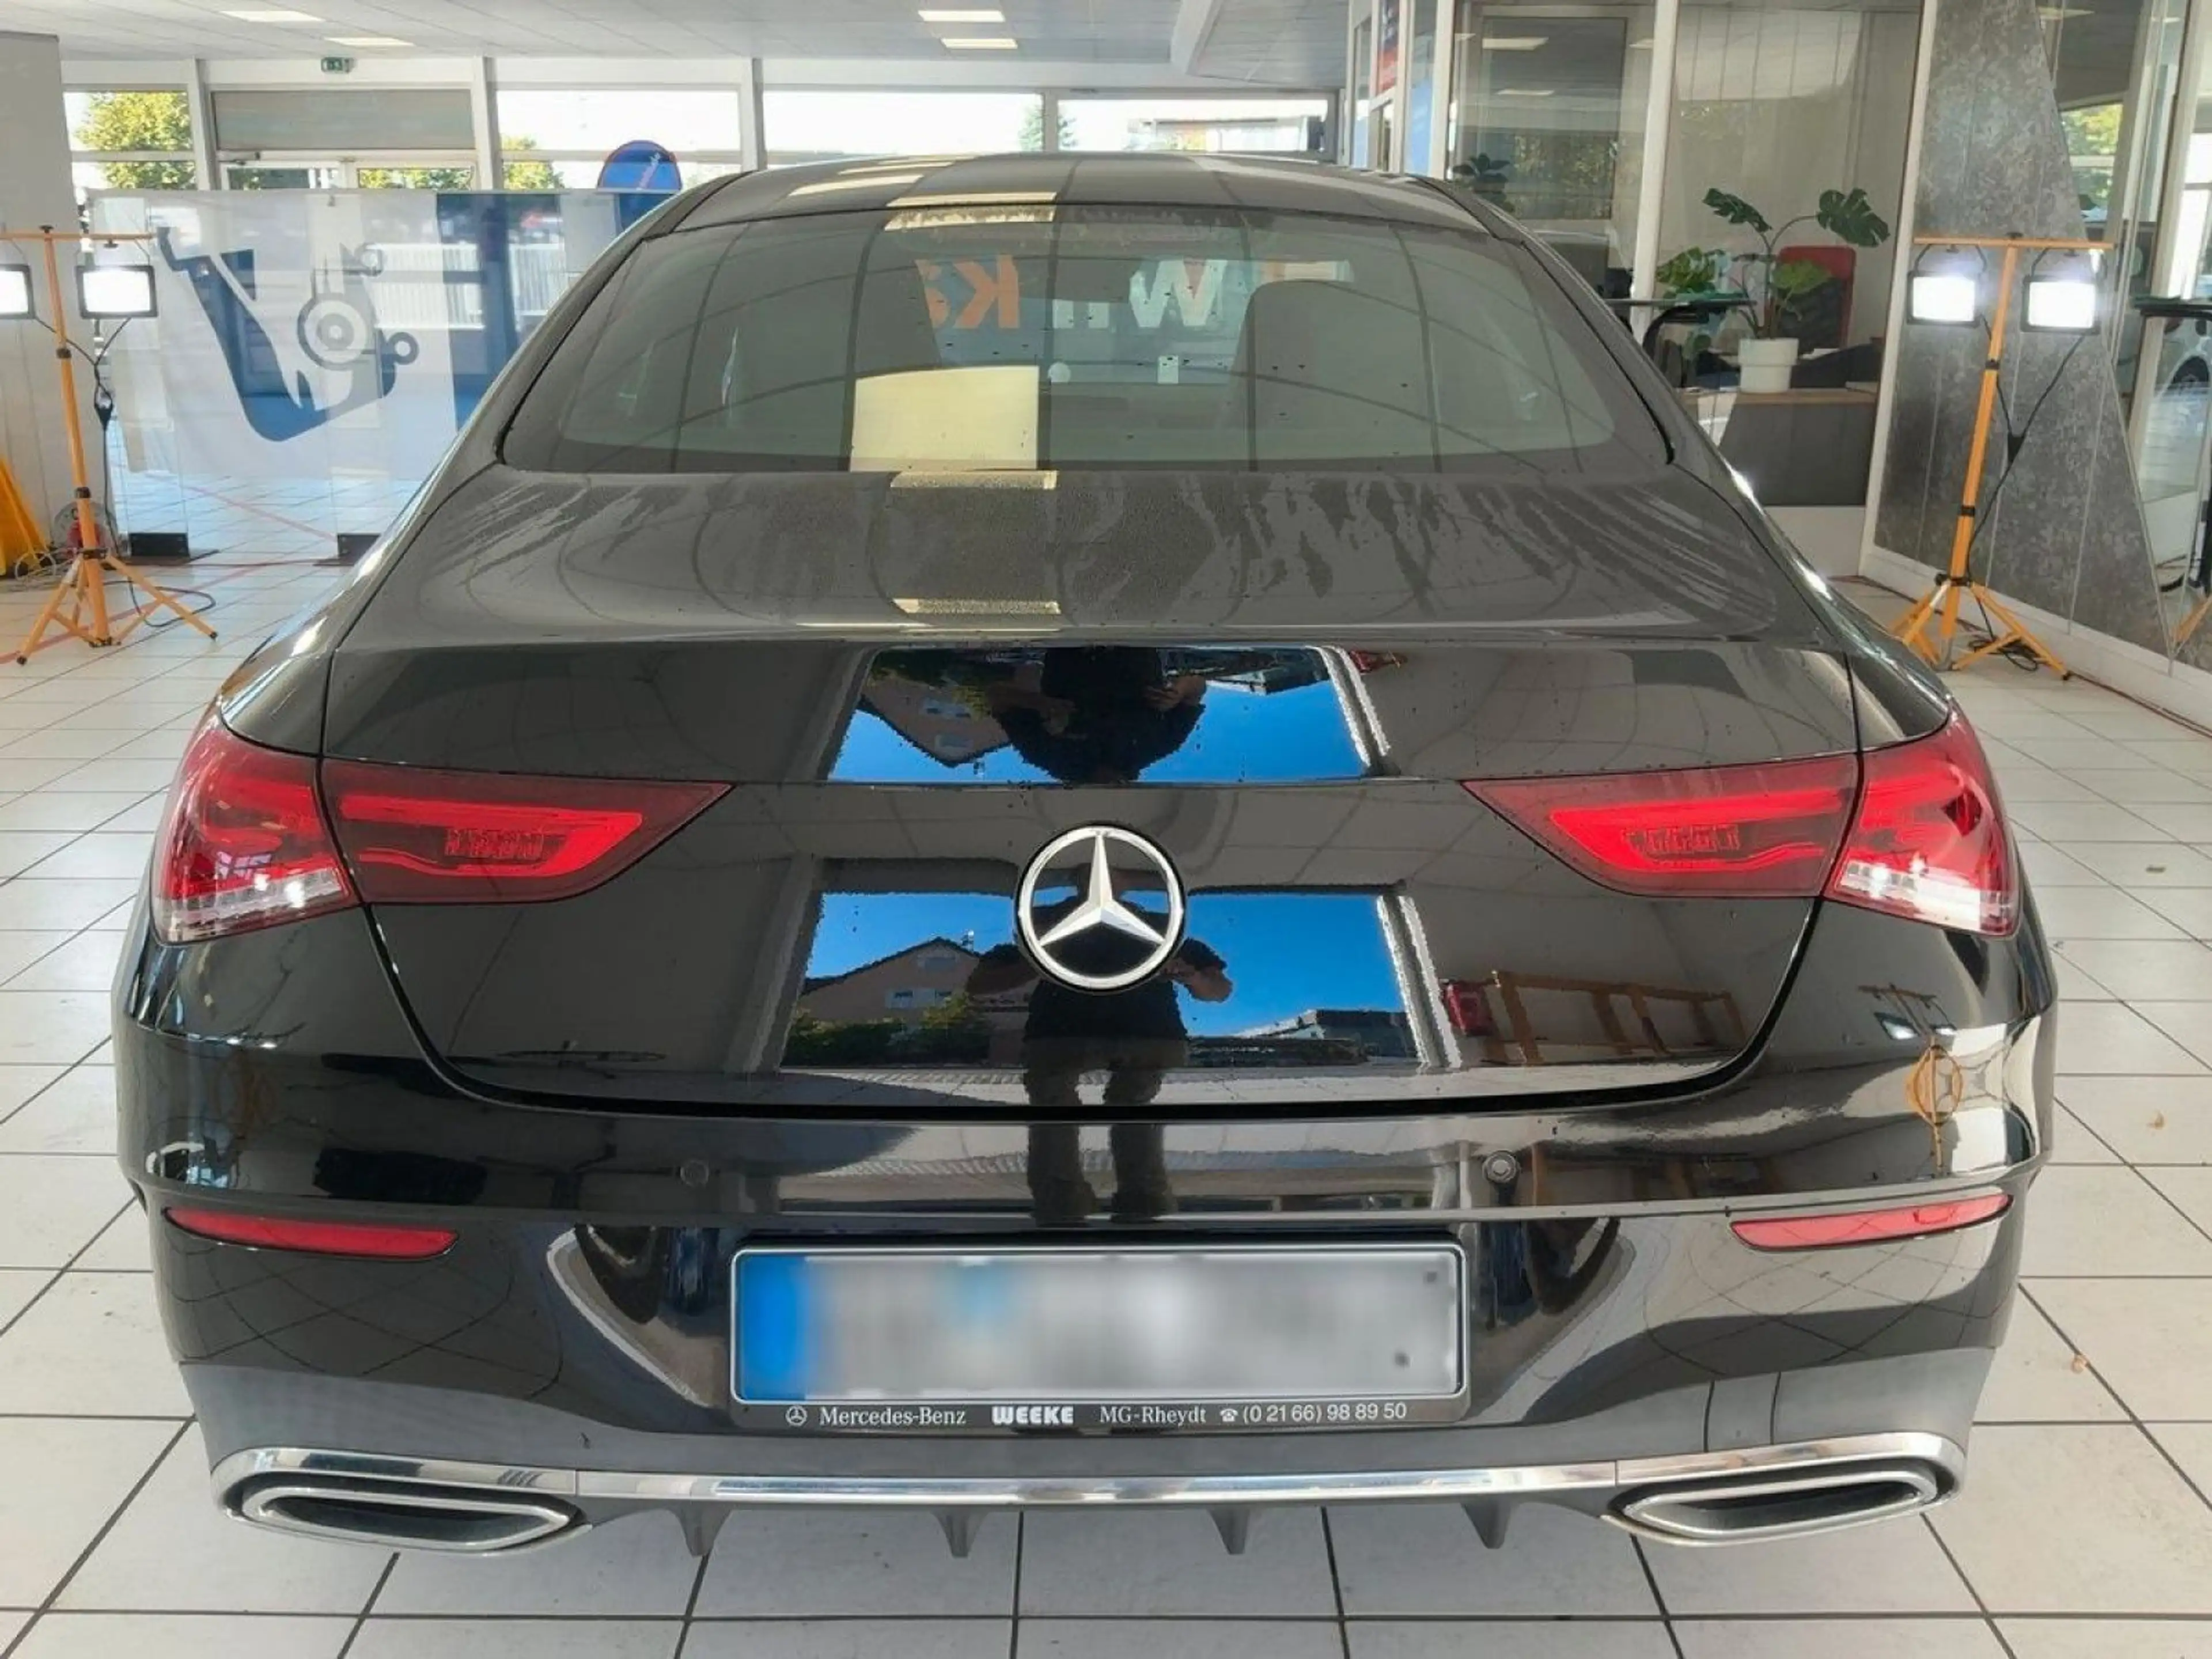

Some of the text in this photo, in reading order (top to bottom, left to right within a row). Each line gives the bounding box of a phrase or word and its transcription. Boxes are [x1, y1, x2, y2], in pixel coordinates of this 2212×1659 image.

[819, 1402, 1407, 1426] Mercedes-Benz WEEKE MG-Rheydt (0 21 66) 98 89 50
